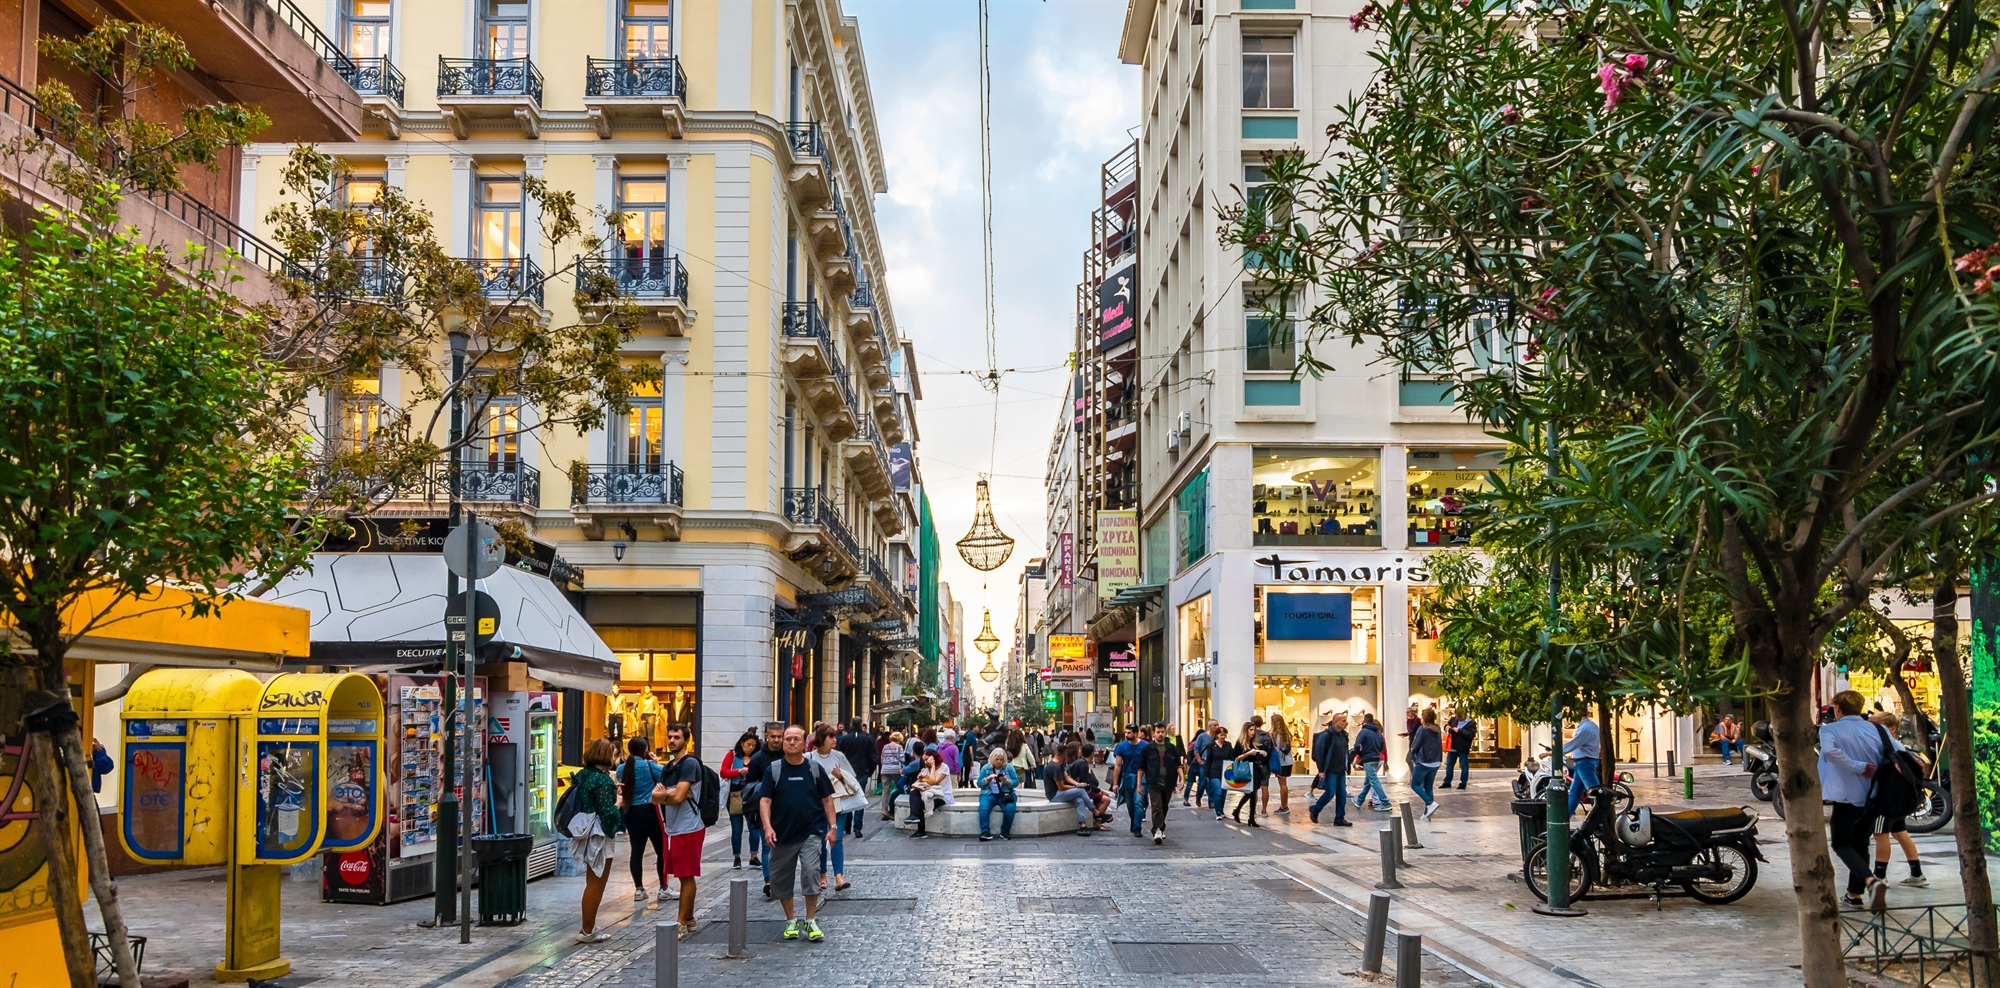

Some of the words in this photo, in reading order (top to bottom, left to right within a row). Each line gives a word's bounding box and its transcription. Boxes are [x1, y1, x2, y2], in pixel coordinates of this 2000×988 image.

[1102, 531, 1135, 543] ΧΡΥΣΑ
[1284, 612, 1315, 620] TOUGH
[1317, 612, 1336, 620] GIRL
[780, 630, 807, 648] H&M
[396, 649, 442, 658] EXECUTIVE
